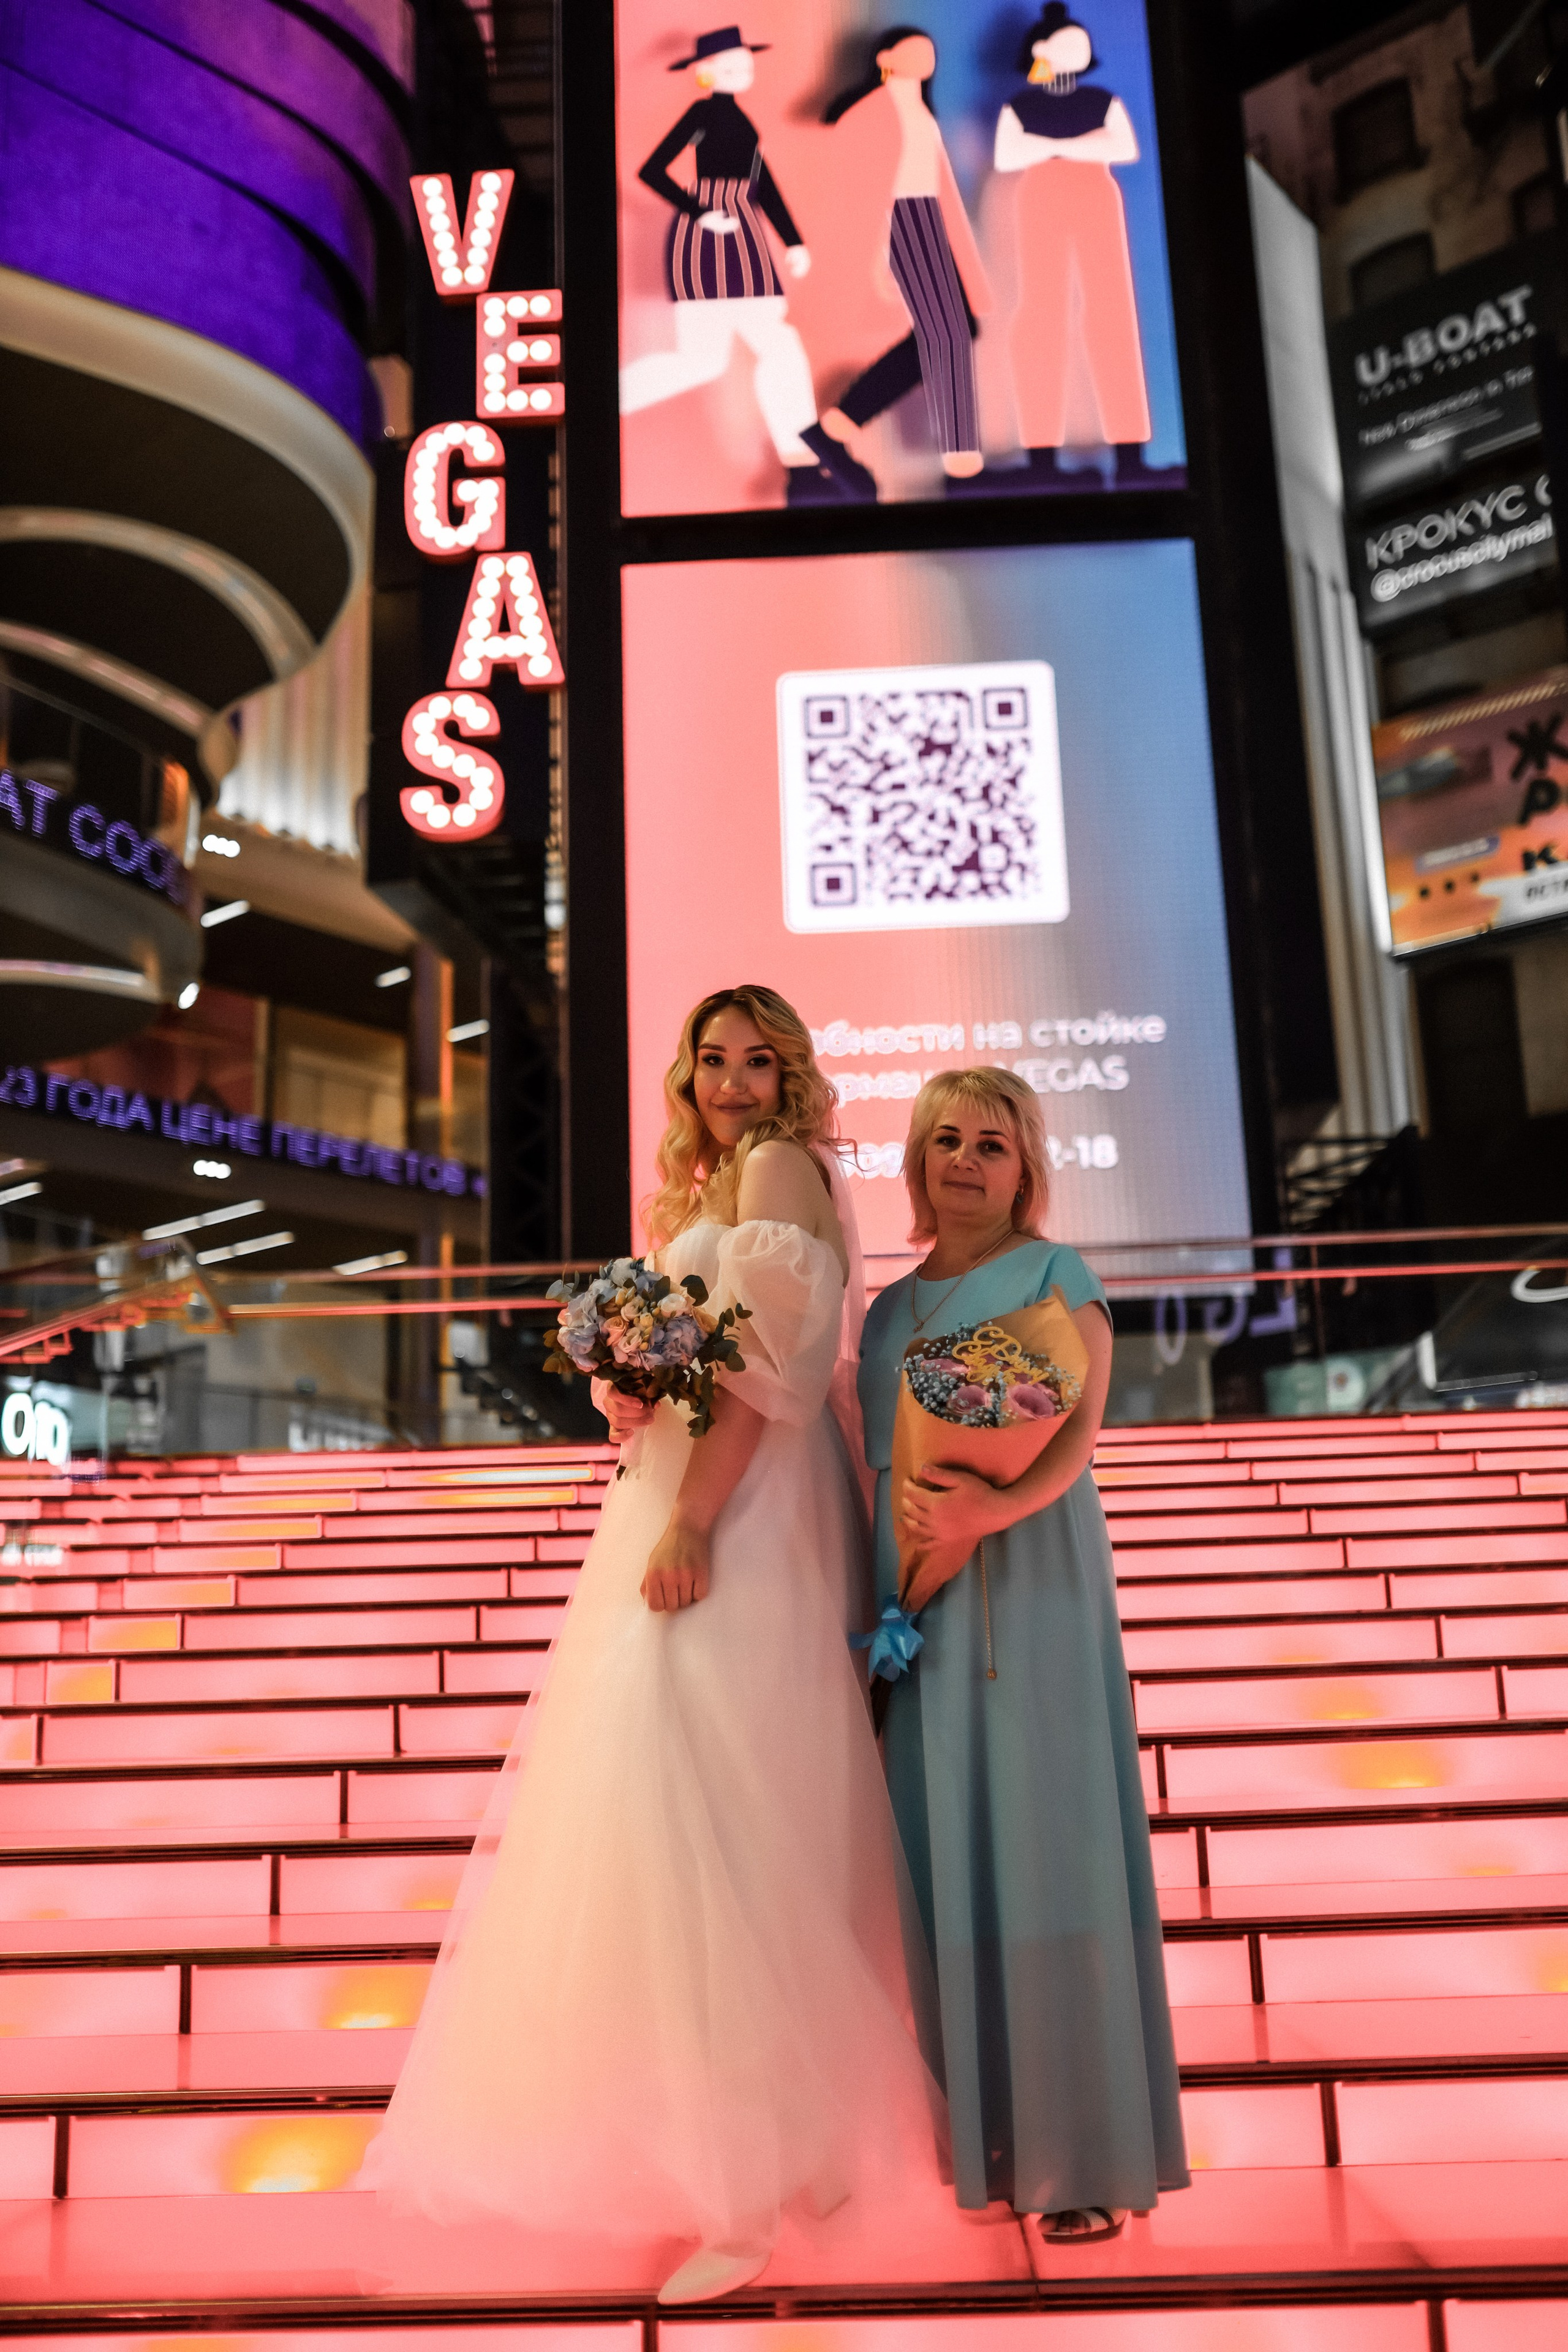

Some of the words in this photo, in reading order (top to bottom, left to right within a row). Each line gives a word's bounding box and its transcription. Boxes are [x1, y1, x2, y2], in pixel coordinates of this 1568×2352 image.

[1355, 284, 1533, 386] U-BOAT
[399, 168, 566, 842] VEGAS
[1366, 484, 1529, 571] КРОКУС
[973, 1022, 1023, 1051] на
[1028, 1010, 1167, 1049] стойке
[45, 1072, 156, 1133] ГОДА
